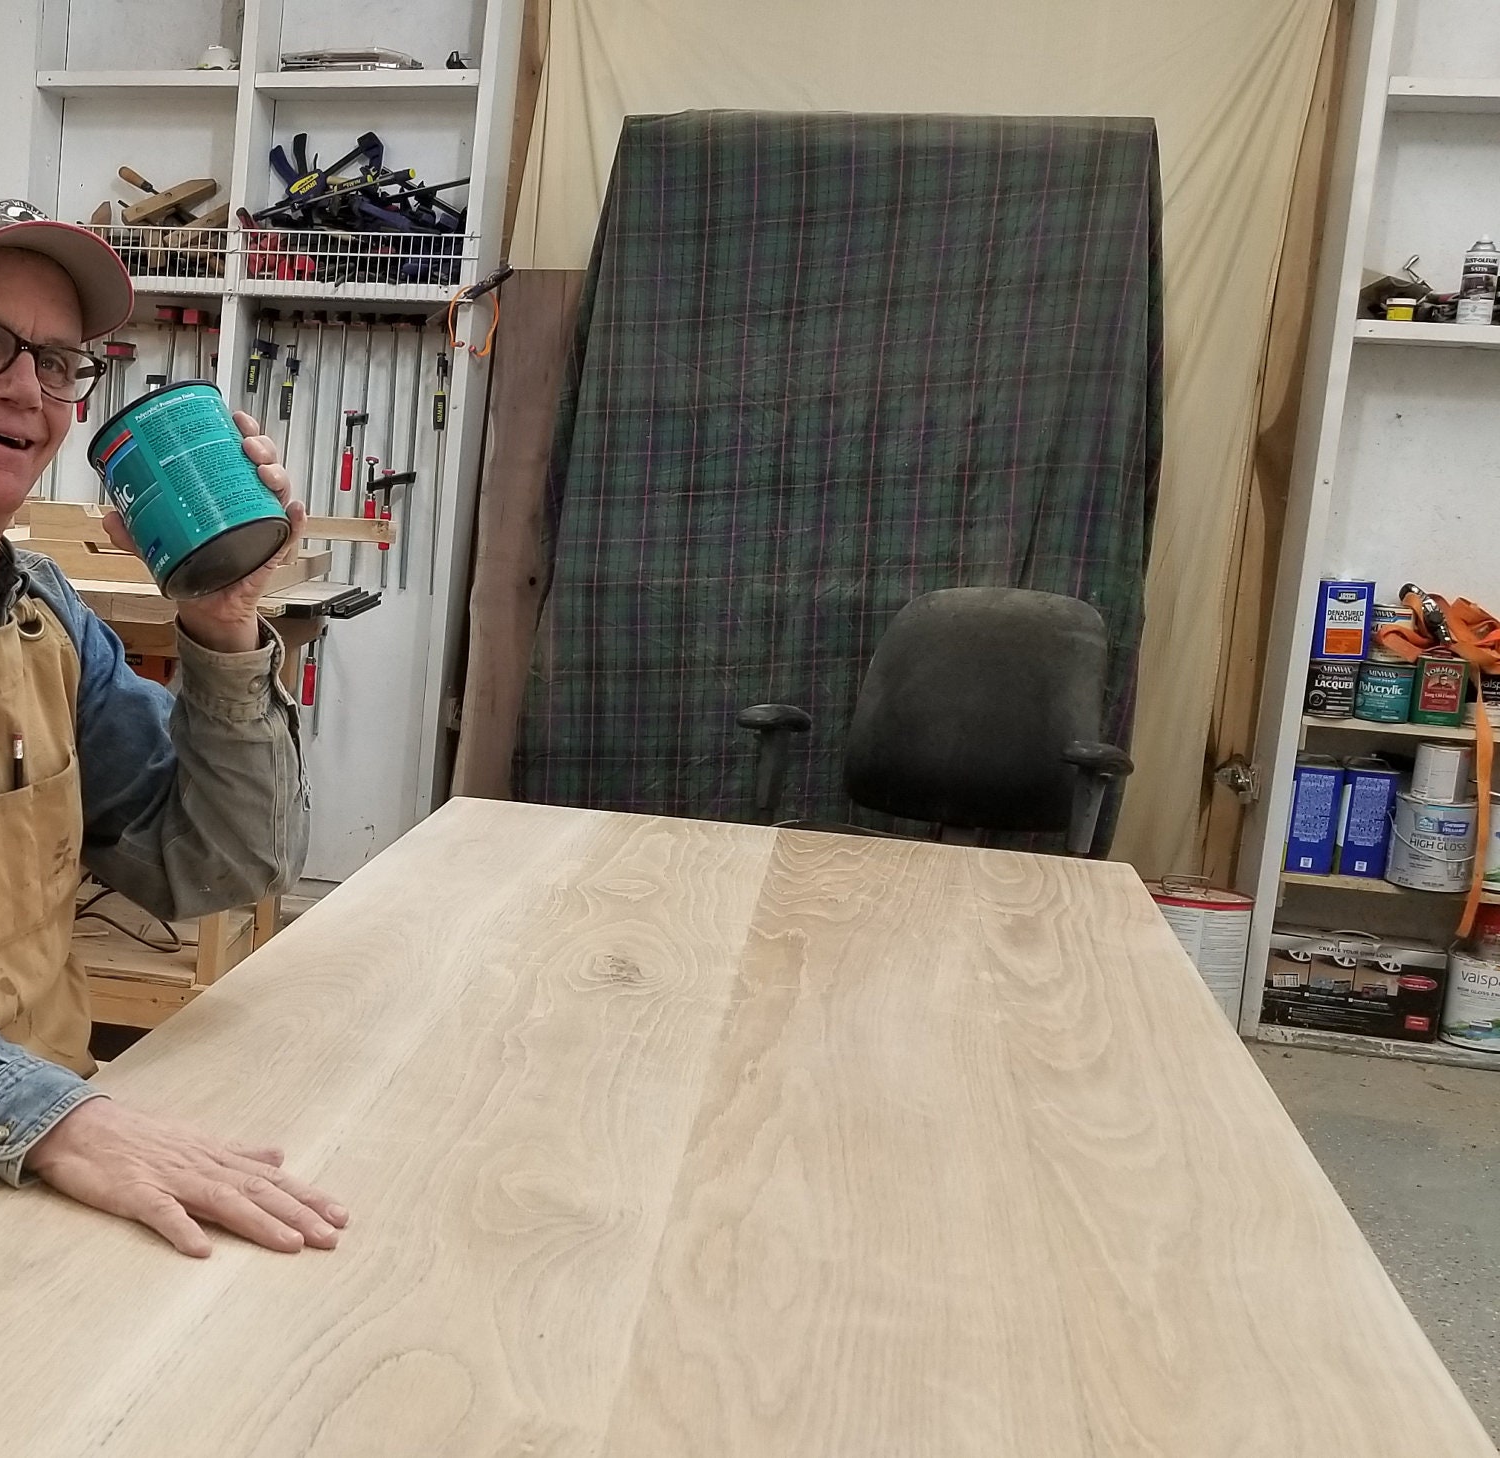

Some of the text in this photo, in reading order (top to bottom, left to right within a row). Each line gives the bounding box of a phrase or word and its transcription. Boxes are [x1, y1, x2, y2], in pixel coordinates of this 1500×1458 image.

[1322, 665, 1352, 673] MINWAX
[1368, 670, 1396, 678] MINWAX
[1483, 679, 1500, 691] alsp
[1409, 837, 1434, 849] HIGH
[1436, 842, 1467, 852] GLOSS
[1461, 970, 1500, 989] valsp
